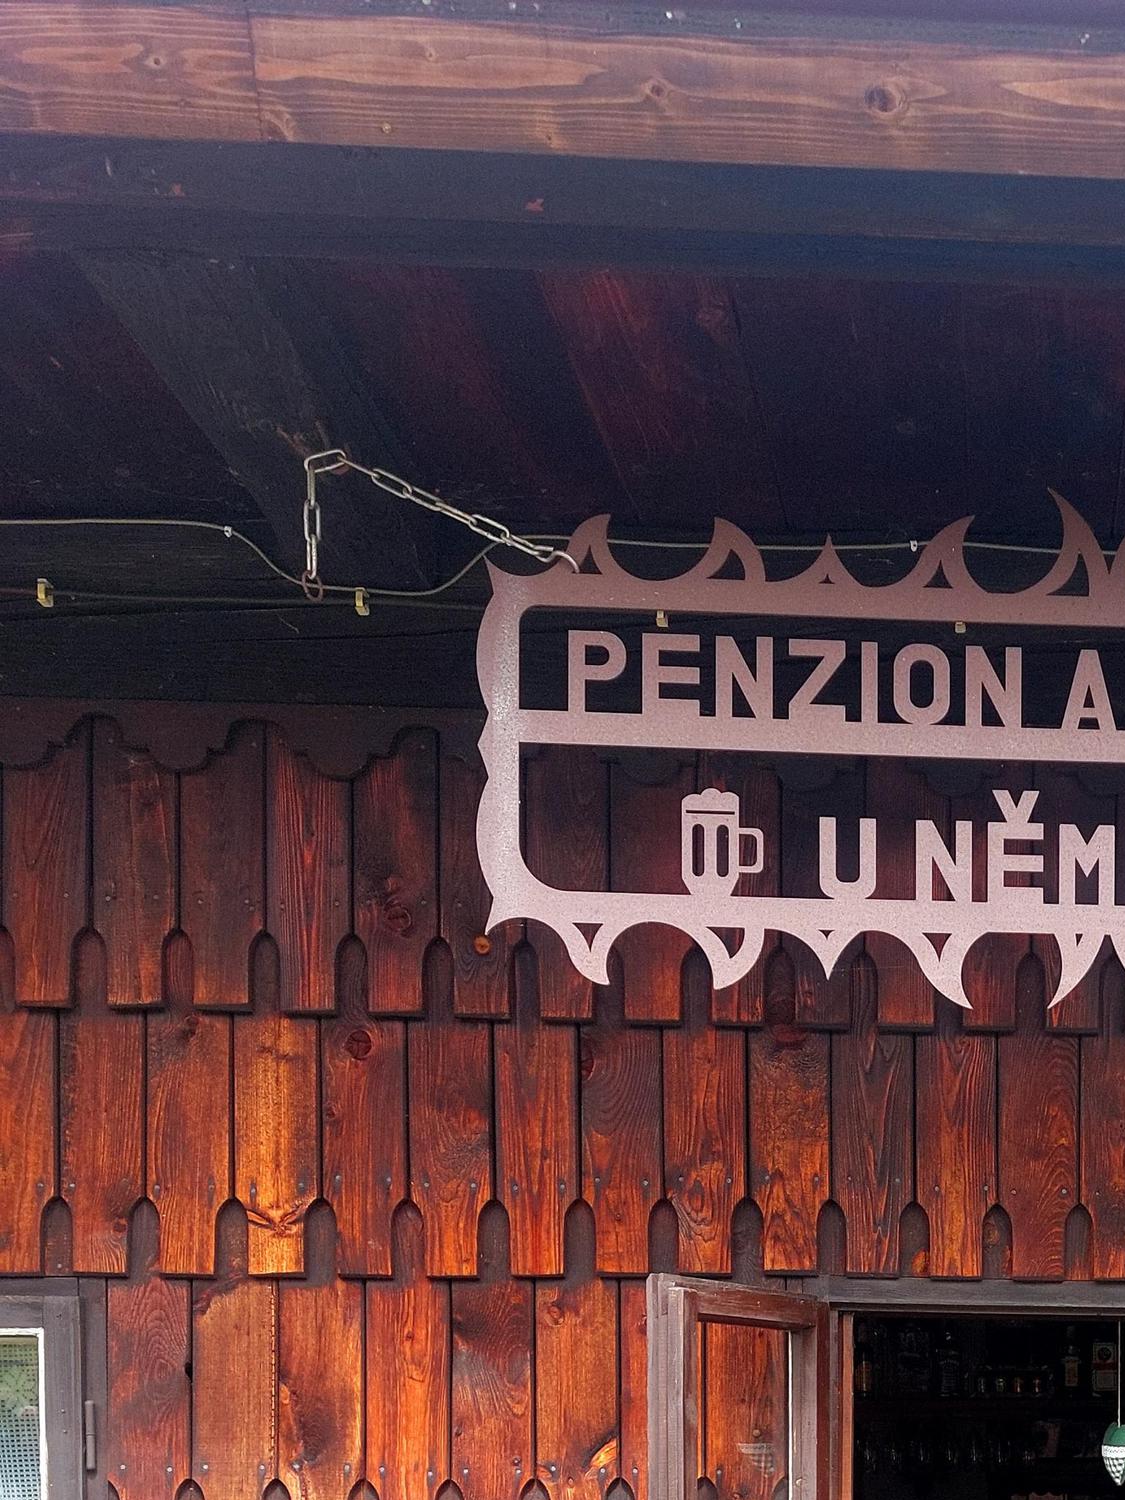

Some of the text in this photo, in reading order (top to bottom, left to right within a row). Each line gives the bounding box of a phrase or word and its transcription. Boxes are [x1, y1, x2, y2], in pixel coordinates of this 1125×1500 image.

[568, 630, 1022, 728] PENZION
[1060, 649, 1118, 731] A
[819, 816, 877, 899] U
